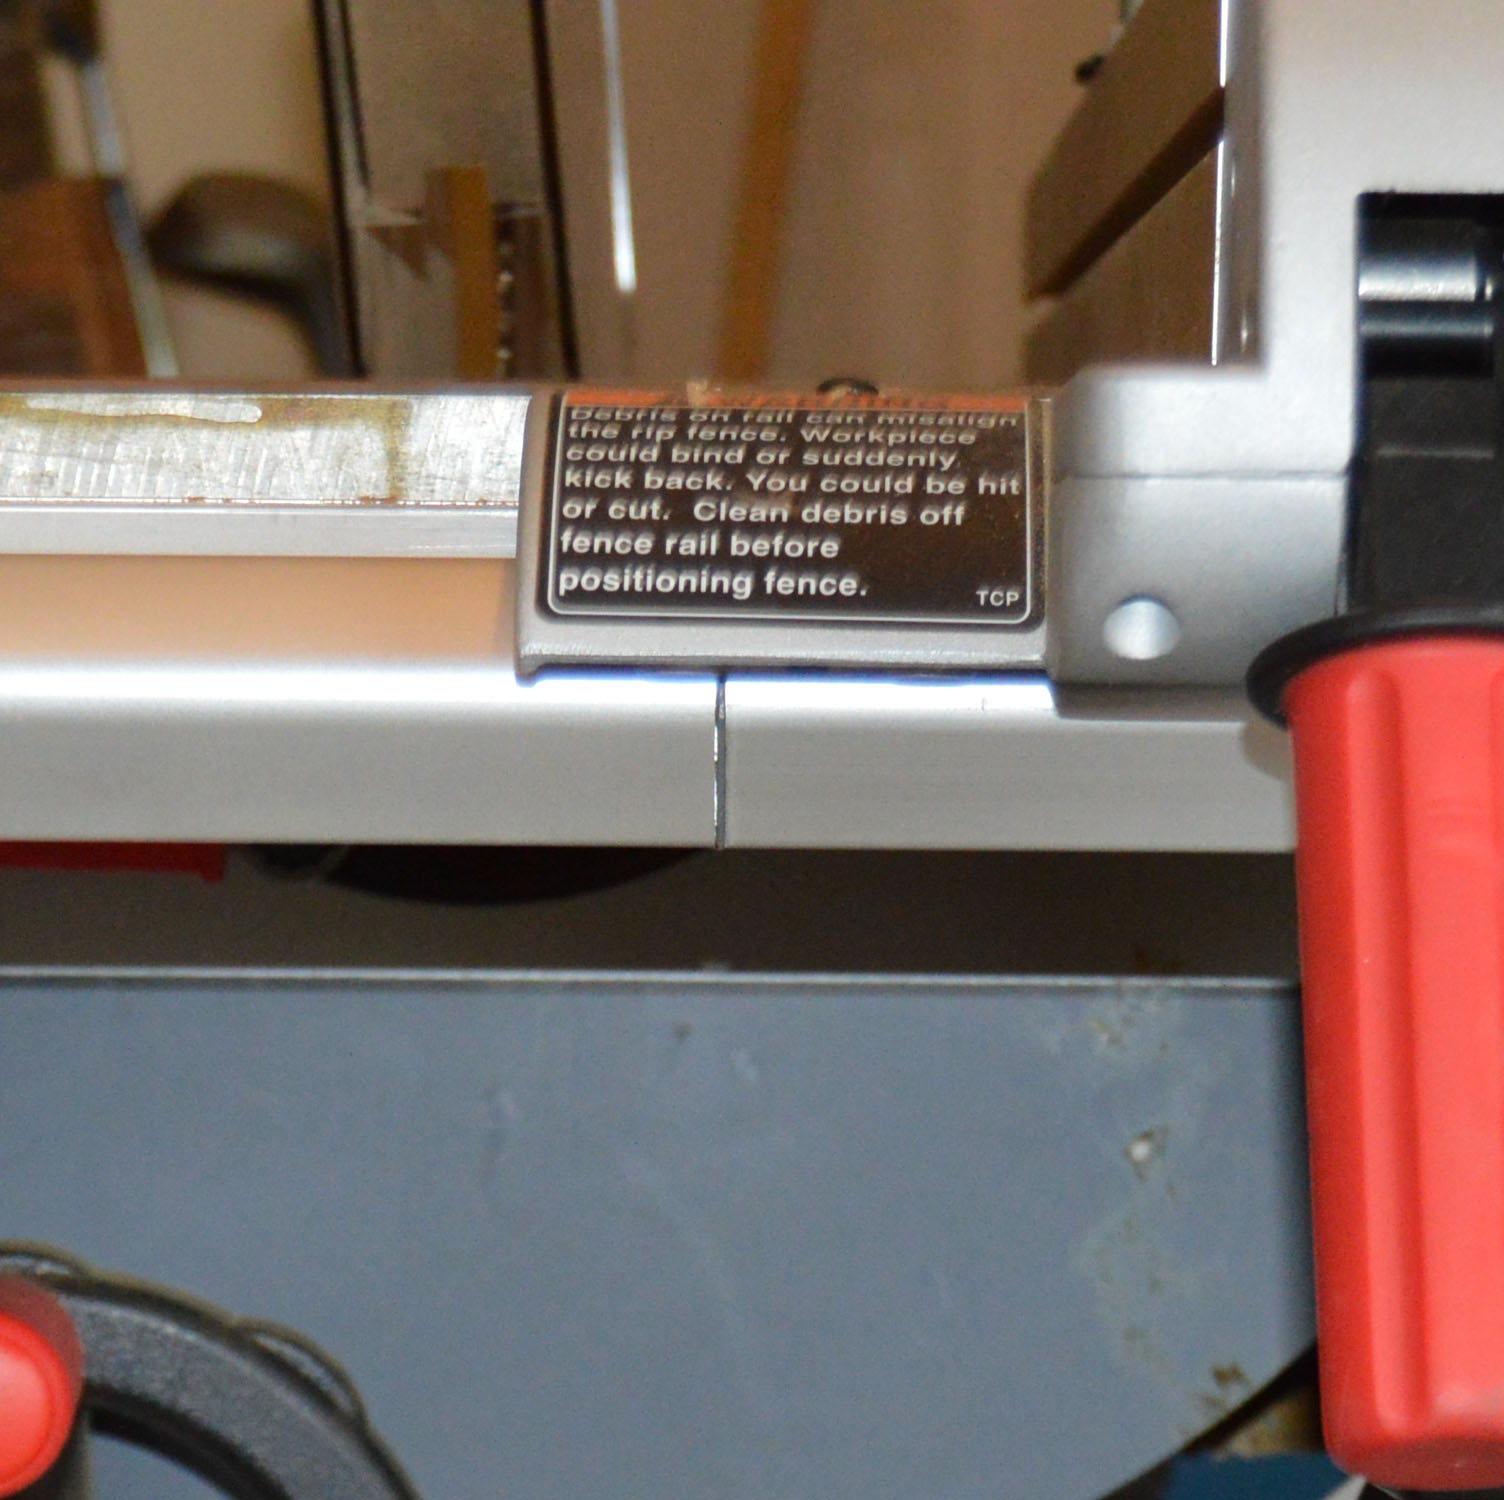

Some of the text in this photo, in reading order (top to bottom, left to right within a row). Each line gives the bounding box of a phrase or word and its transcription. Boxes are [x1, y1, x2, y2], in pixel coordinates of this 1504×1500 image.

[572, 407, 1017, 429] Debris on rail can misalign
[569, 422, 976, 446] the rip fence. Workpiece
[566, 443, 958, 470] could bind or suddenly
[565, 468, 1020, 496] kick back. You could be hit
[562, 500, 966, 526] or cut. Clean debris off
[561, 531, 841, 558] fence rail before
[559, 566, 869, 600] positioning fence.
[976, 589, 1020, 607] TCP
